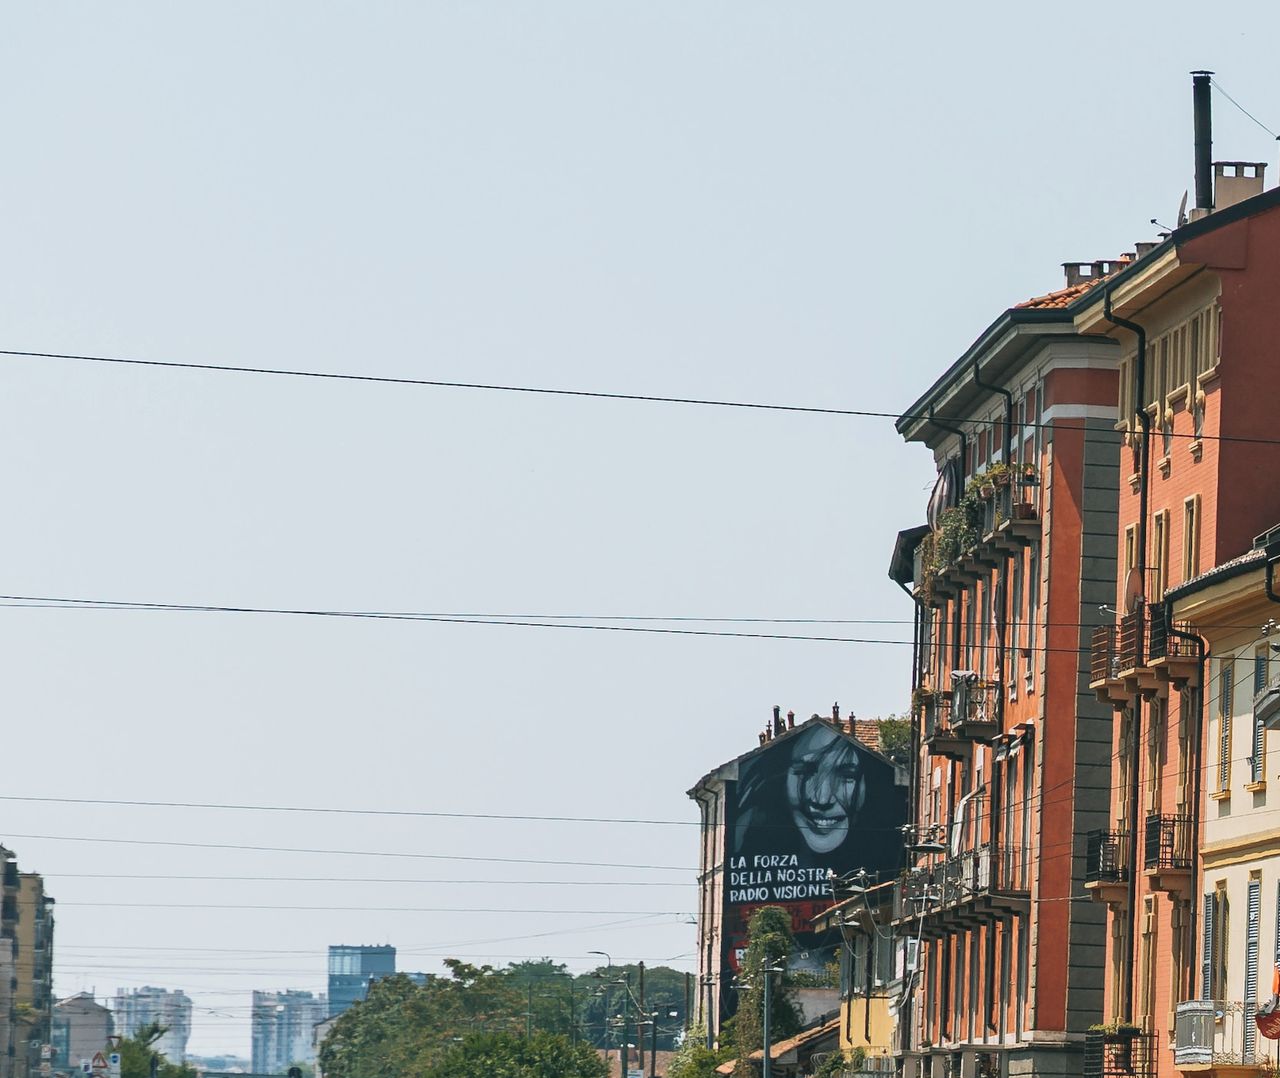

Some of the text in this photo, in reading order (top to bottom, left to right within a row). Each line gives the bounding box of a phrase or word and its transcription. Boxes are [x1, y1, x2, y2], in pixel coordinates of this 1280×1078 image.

[730, 854, 798, 869] LA FORZA
[731, 867, 832, 886] DELLA NOSTRA
[730, 883, 830, 902] RADIO VISIONE
